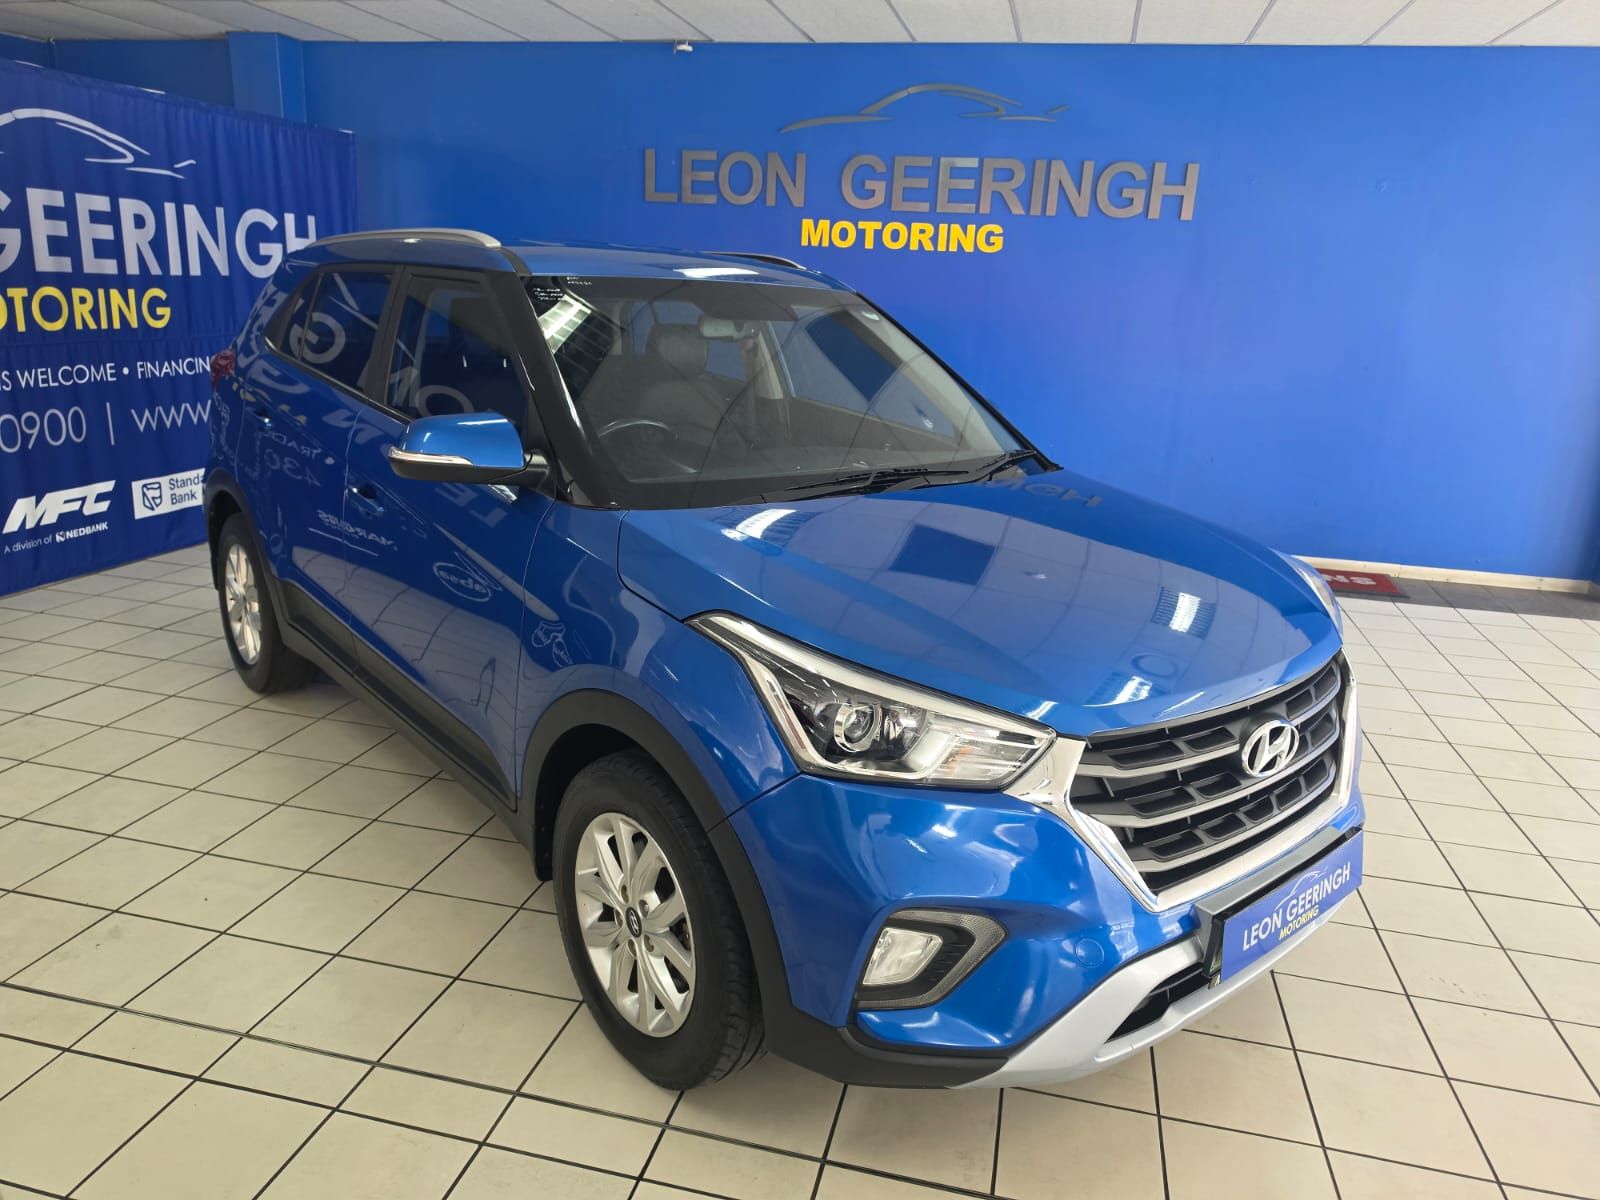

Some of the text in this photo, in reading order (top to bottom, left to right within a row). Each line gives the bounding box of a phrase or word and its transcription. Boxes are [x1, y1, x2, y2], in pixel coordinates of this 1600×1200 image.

[643, 148, 1200, 221] LEON GEERINGH
[800, 218, 1005, 254] MOTORING
[0, 286, 172, 333] TORING
[16, 362, 118, 390] WELCOME
[136, 355, 213, 380] FINANCIN
[2, 479, 116, 535] MFC
[170, 489, 198, 505] Bank
[12, 537, 43, 553] division
[44, 535, 53, 545] of
[66, 521, 109, 540] NEDBANK
[1242, 861, 1351, 952] LEON GEERINGH
[1278, 904, 1319, 941] MOTORING
